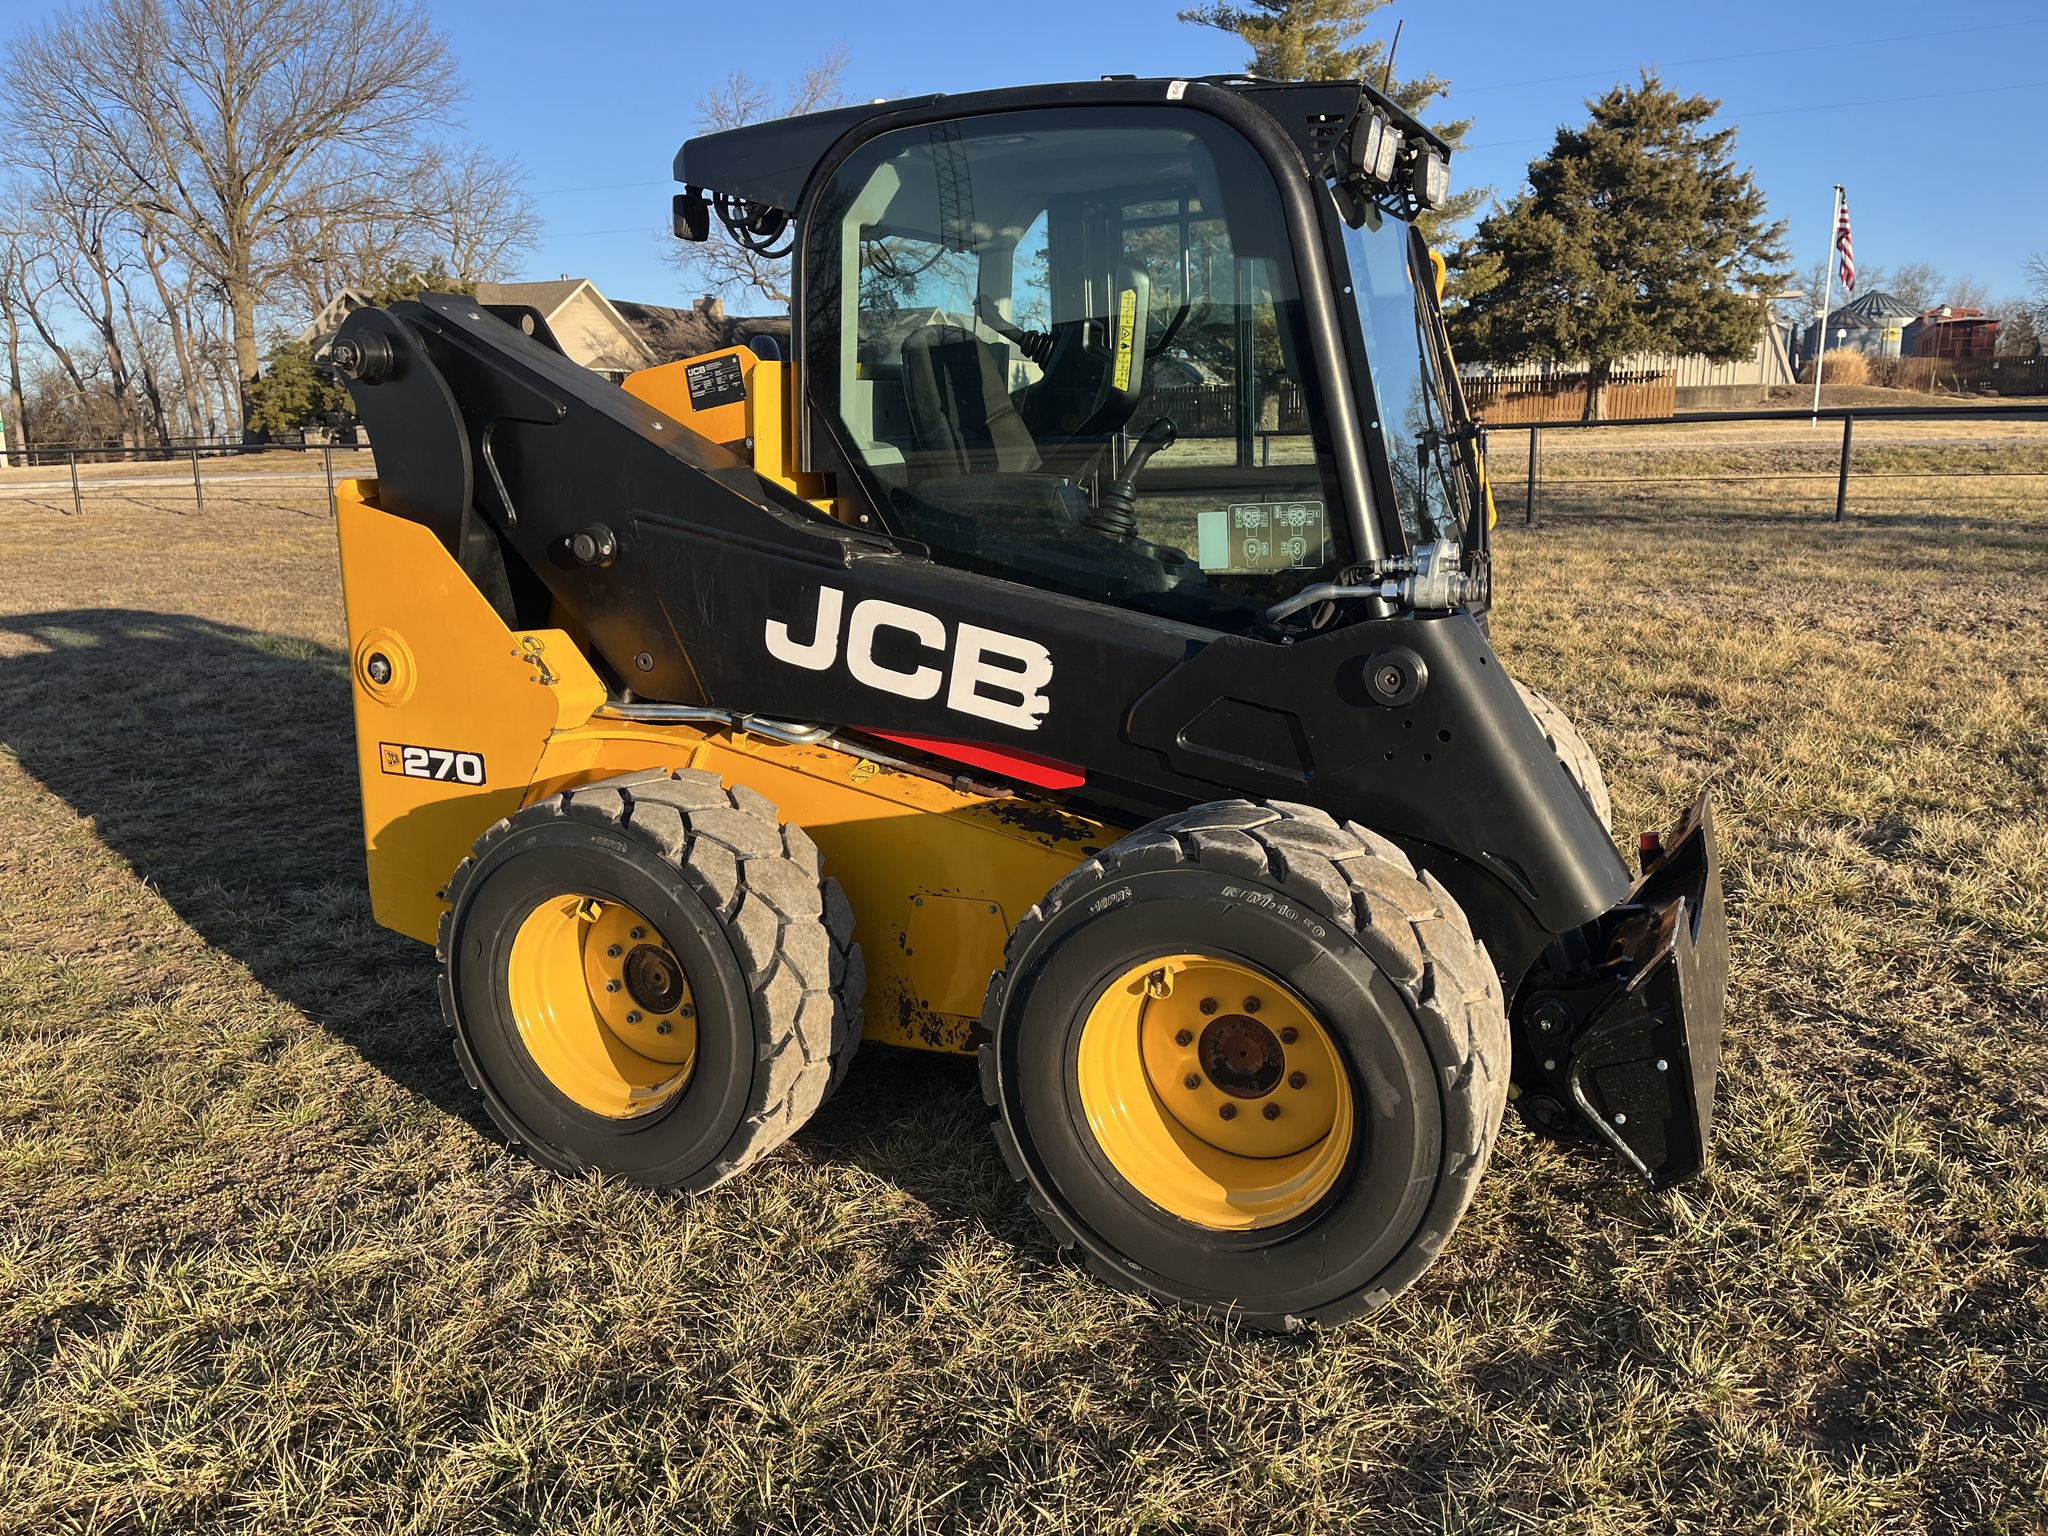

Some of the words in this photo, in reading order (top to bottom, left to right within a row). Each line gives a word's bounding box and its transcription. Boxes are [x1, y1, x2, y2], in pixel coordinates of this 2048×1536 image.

[688, 366, 706, 376] JCB
[765, 585, 1054, 731] JCB
[403, 747, 483, 784] 270
